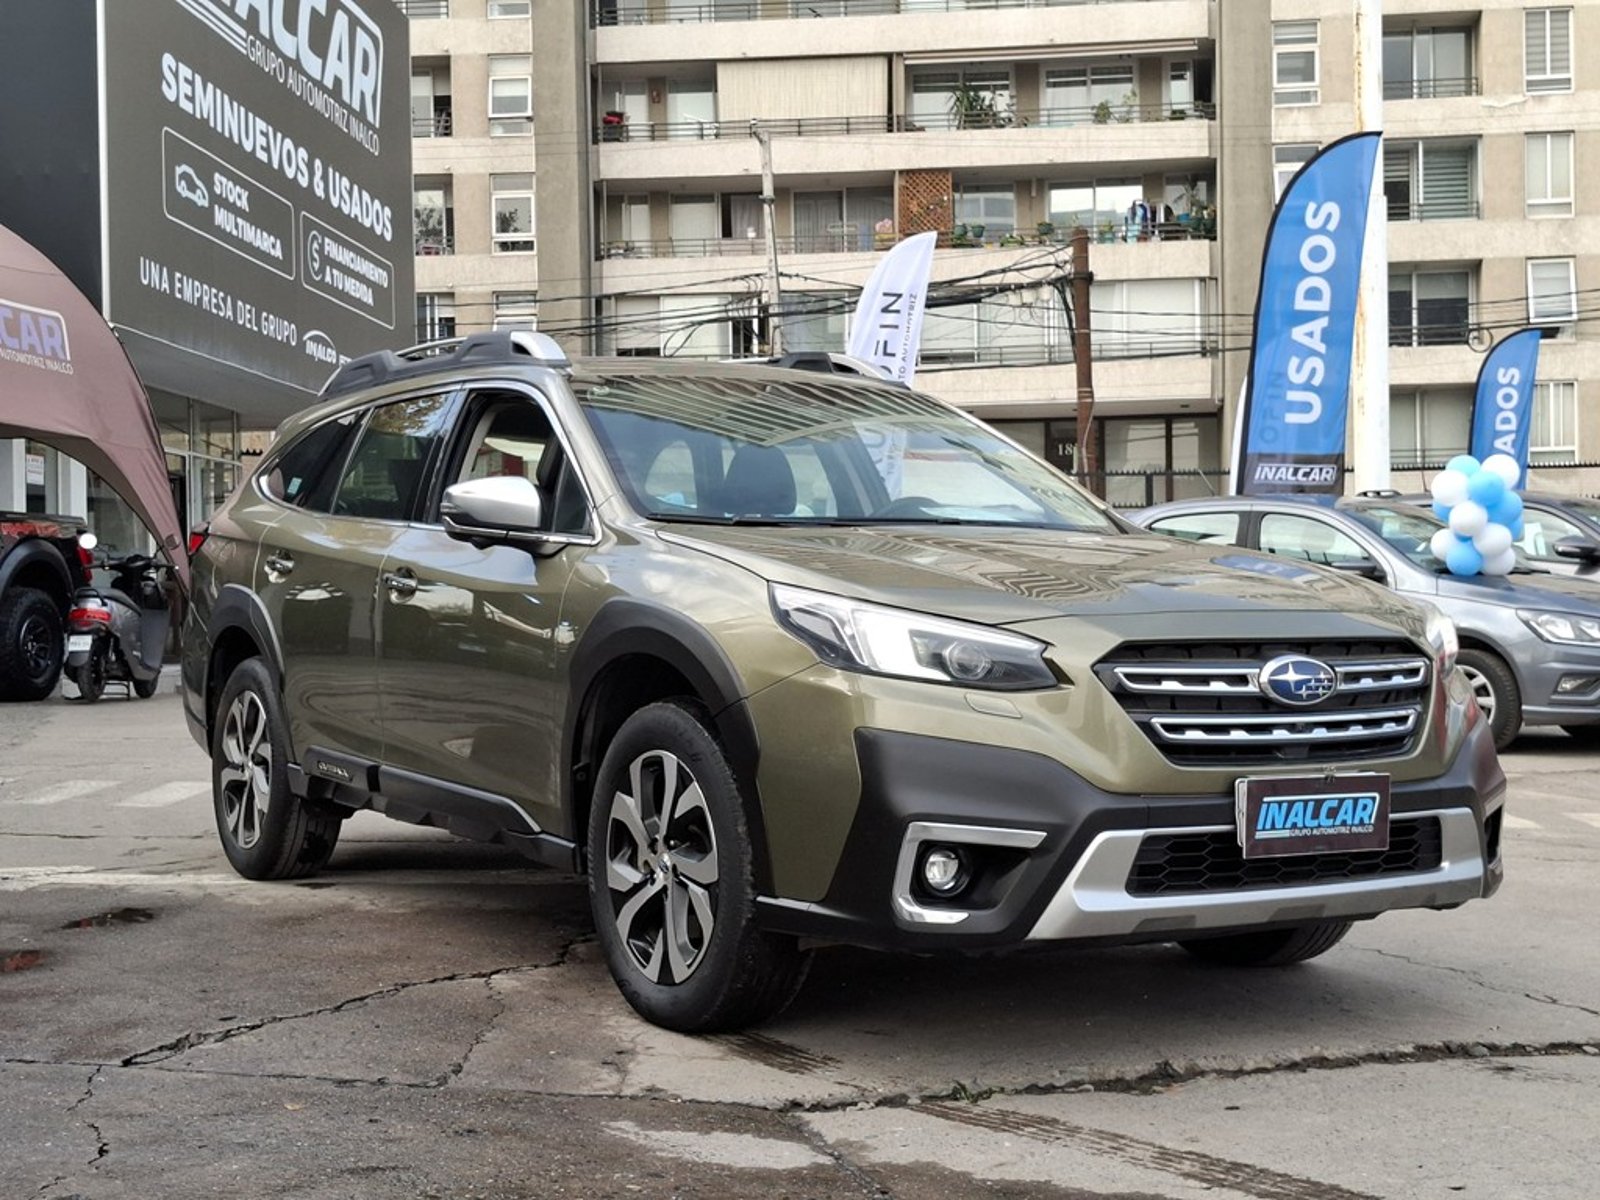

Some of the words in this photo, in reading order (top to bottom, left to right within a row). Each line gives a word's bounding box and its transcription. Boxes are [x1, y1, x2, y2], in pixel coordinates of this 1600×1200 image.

[247, 35, 285, 83] GRUPO
[287, 66, 348, 133] AUTOMOTRIZ
[349, 113, 379, 156] INALCO
[161, 53, 309, 188] SEMINUEVOS
[313, 158, 325, 200] &
[328, 166, 392, 242] USADOS
[213, 172, 249, 212] STOCK
[214, 205, 283, 260] MULTIMARCA
[324, 238, 388, 288] FINANCIAMIENTO
[324, 265, 332, 285] A
[332, 268, 343, 290] TU
[344, 275, 374, 307] MEDIDA
[140, 257, 170, 294] UNA
[175, 272, 233, 321] EMPRESA
[237, 300, 258, 332] DEL
[261, 308, 298, 346] GRUPO
[1284, 200, 1341, 425] USADOS
[0, 305, 67, 361] CAR
[1493, 367, 1520, 455] ADOS
[1253, 465, 1333, 482] INALCAR
[1256, 798, 1374, 830] INALCAR
